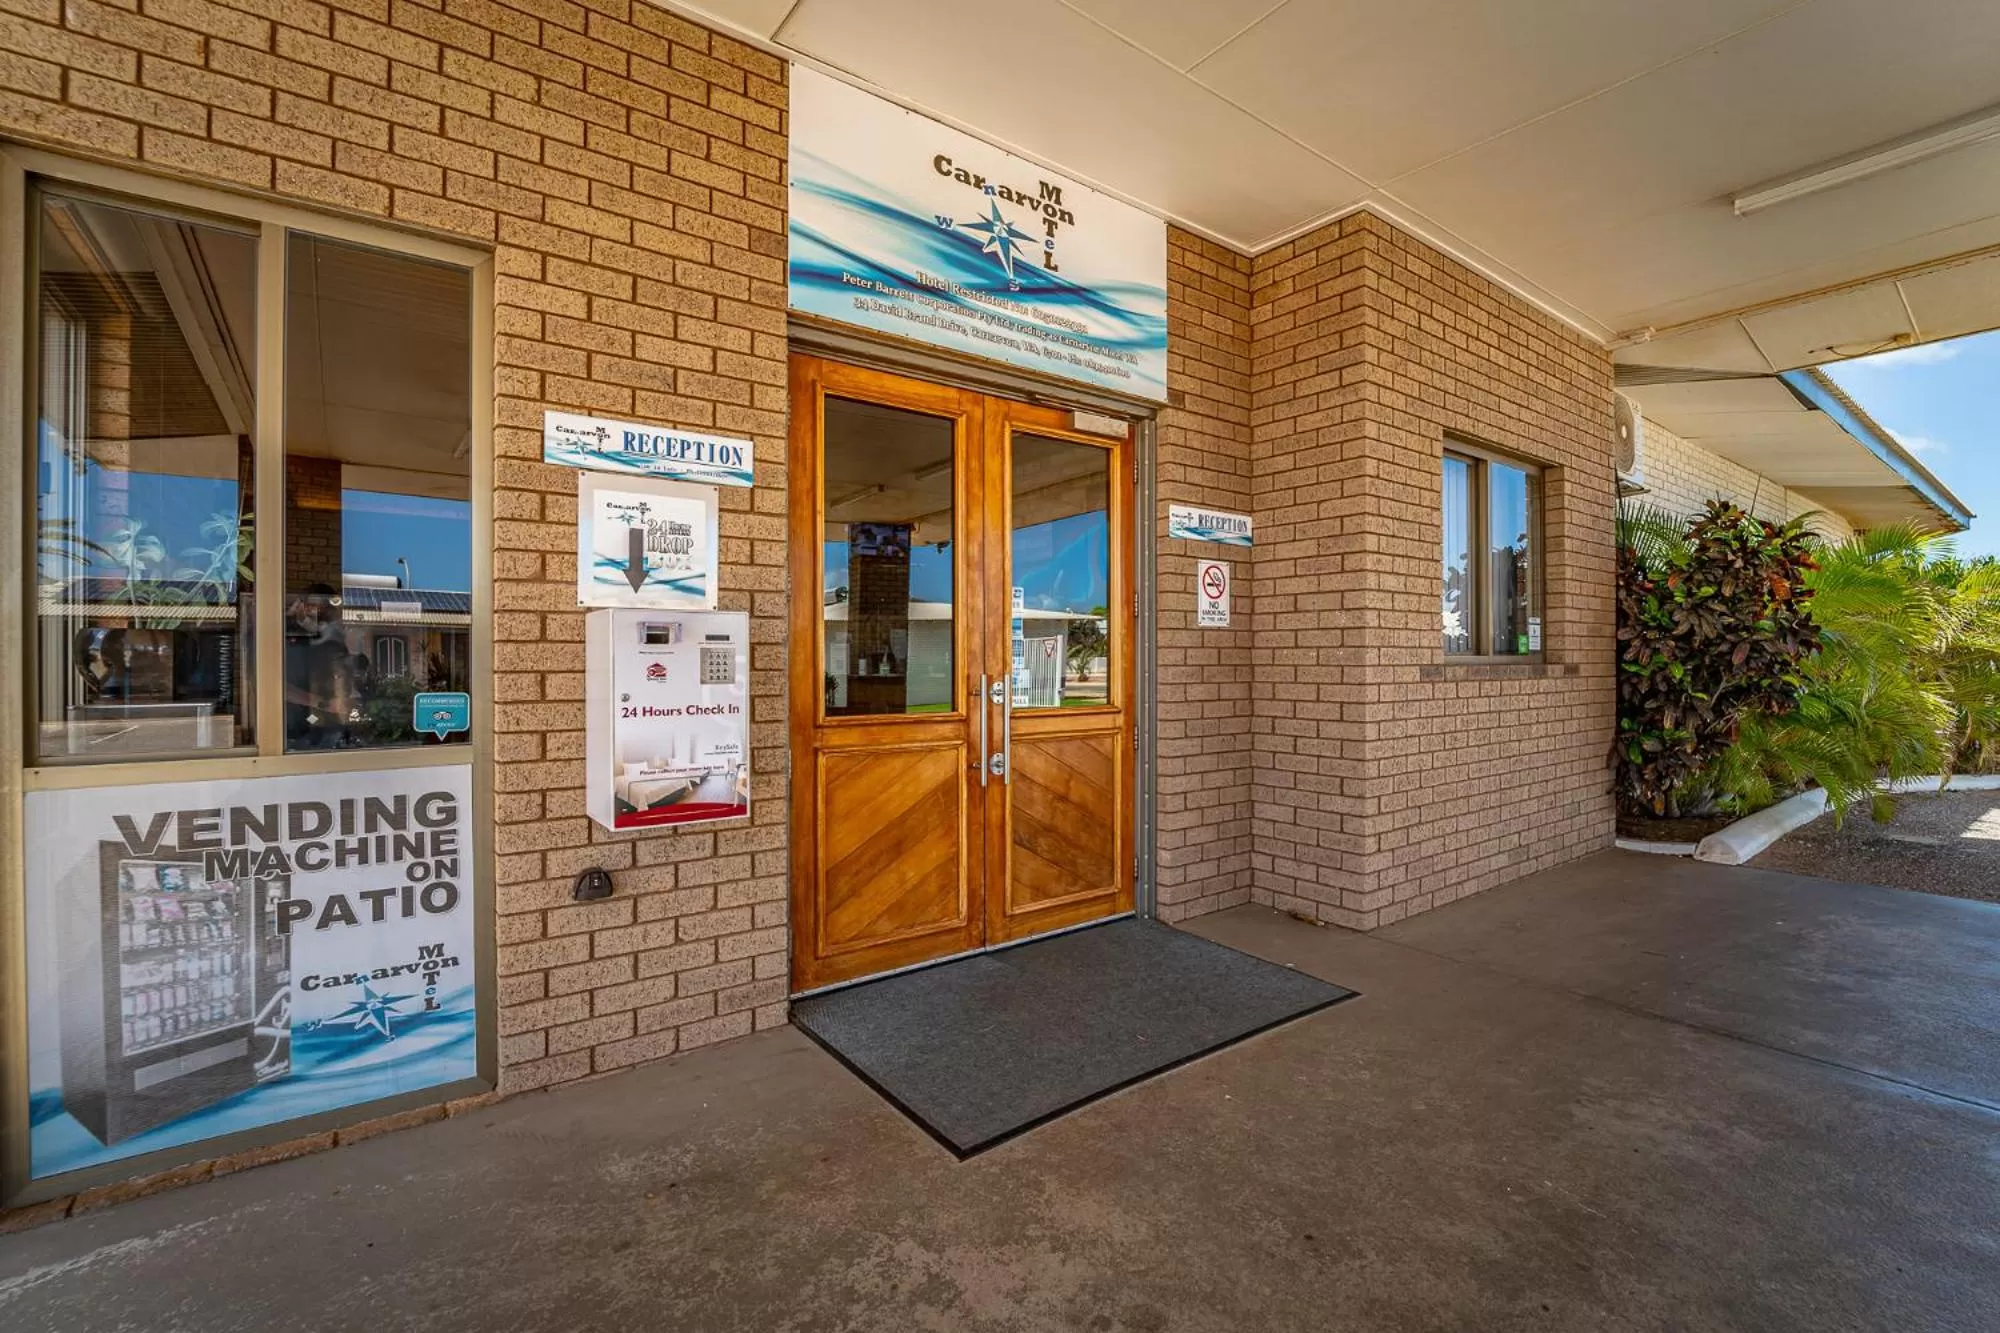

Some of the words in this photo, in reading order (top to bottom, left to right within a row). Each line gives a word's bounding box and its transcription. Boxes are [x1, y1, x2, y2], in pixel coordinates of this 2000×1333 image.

[933, 154, 1075, 226] Carnarvon
[842, 271, 873, 289] Peter
[875, 281, 916, 301] Barrett
[978, 310, 993, 326] Pty
[1016, 323, 1049, 341] trading
[916, 270, 950, 292] Hotel
[952, 281, 1009, 311] Restricted
[870, 299, 903, 318] David
[622, 430, 744, 467] RECEPTION
[647, 519, 668, 536] 24
[1197, 513, 1249, 533] RECEPTION
[647, 535, 694, 555] DROP
[1202, 609, 1226, 617] SMOKING
[1208, 600, 1219, 610] NO
[621, 706, 637, 719] 24
[642, 704, 682, 718] Hours
[686, 704, 724, 716] Check
[728, 703, 740, 715] In
[112, 790, 459, 857] VENDING
[202, 827, 460, 885] MACHINE
[405, 857, 459, 883] ON
[275, 880, 460, 937] PATIO
[300, 954, 460, 992] Carnarvon
